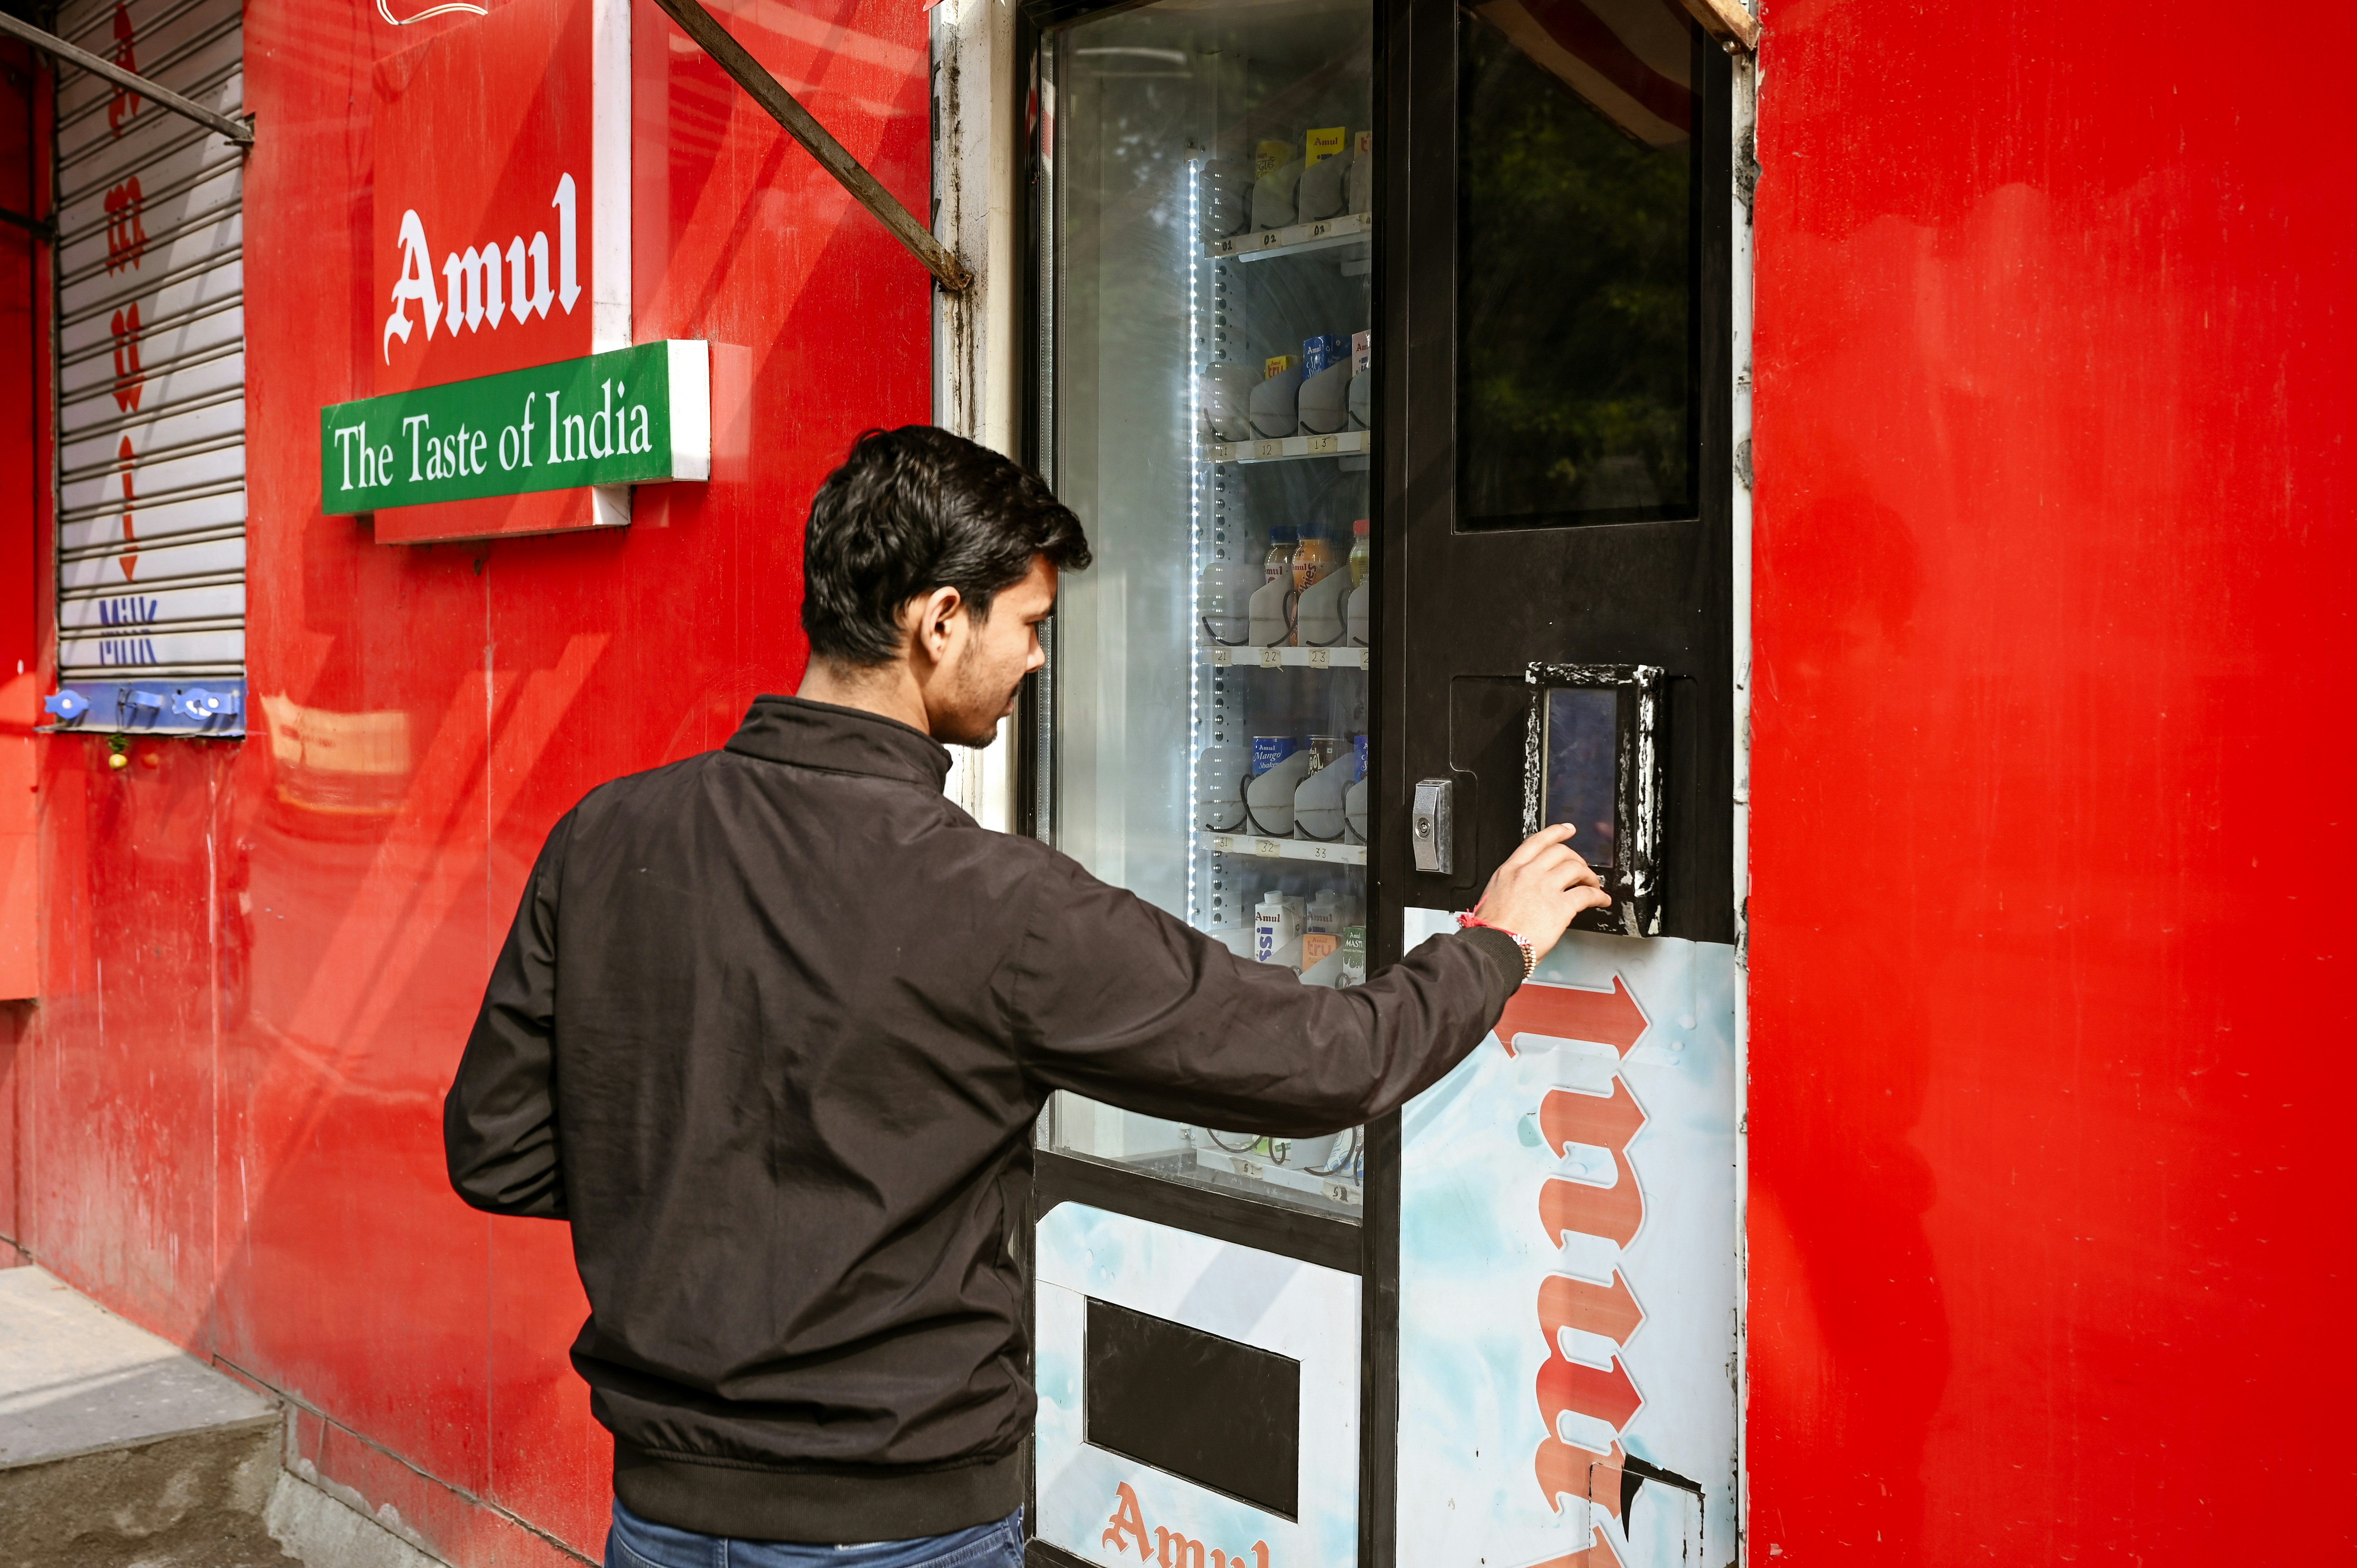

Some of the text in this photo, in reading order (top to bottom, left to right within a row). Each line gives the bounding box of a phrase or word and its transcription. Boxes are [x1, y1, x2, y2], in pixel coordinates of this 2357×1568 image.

[1314, 137, 1338, 146] Amul
[1222, 240, 1232, 251] 01
[1264, 234, 1276, 246] 02
[384, 172, 581, 366] Amul
[1307, 344, 1321, 355] Amul
[334, 378, 652, 491] The Taste of India
[1315, 437, 1328, 449] 13
[1263, 444, 1272, 455] 12
[1218, 651, 1226, 661] 21
[1265, 651, 1276, 662] 22
[1312, 651, 1326, 663] 23
[1253, 752, 1281, 762] Mango
[1219, 837, 1228, 847] 31
[1262, 842, 1273, 852] 32
[1315, 847, 1326, 858] 33
[1256, 911, 1280, 922] Amul
[1307, 911, 1333, 922] Amul
[1307, 941, 1331, 957] tru
[1345, 939, 1363, 948] MASTI
